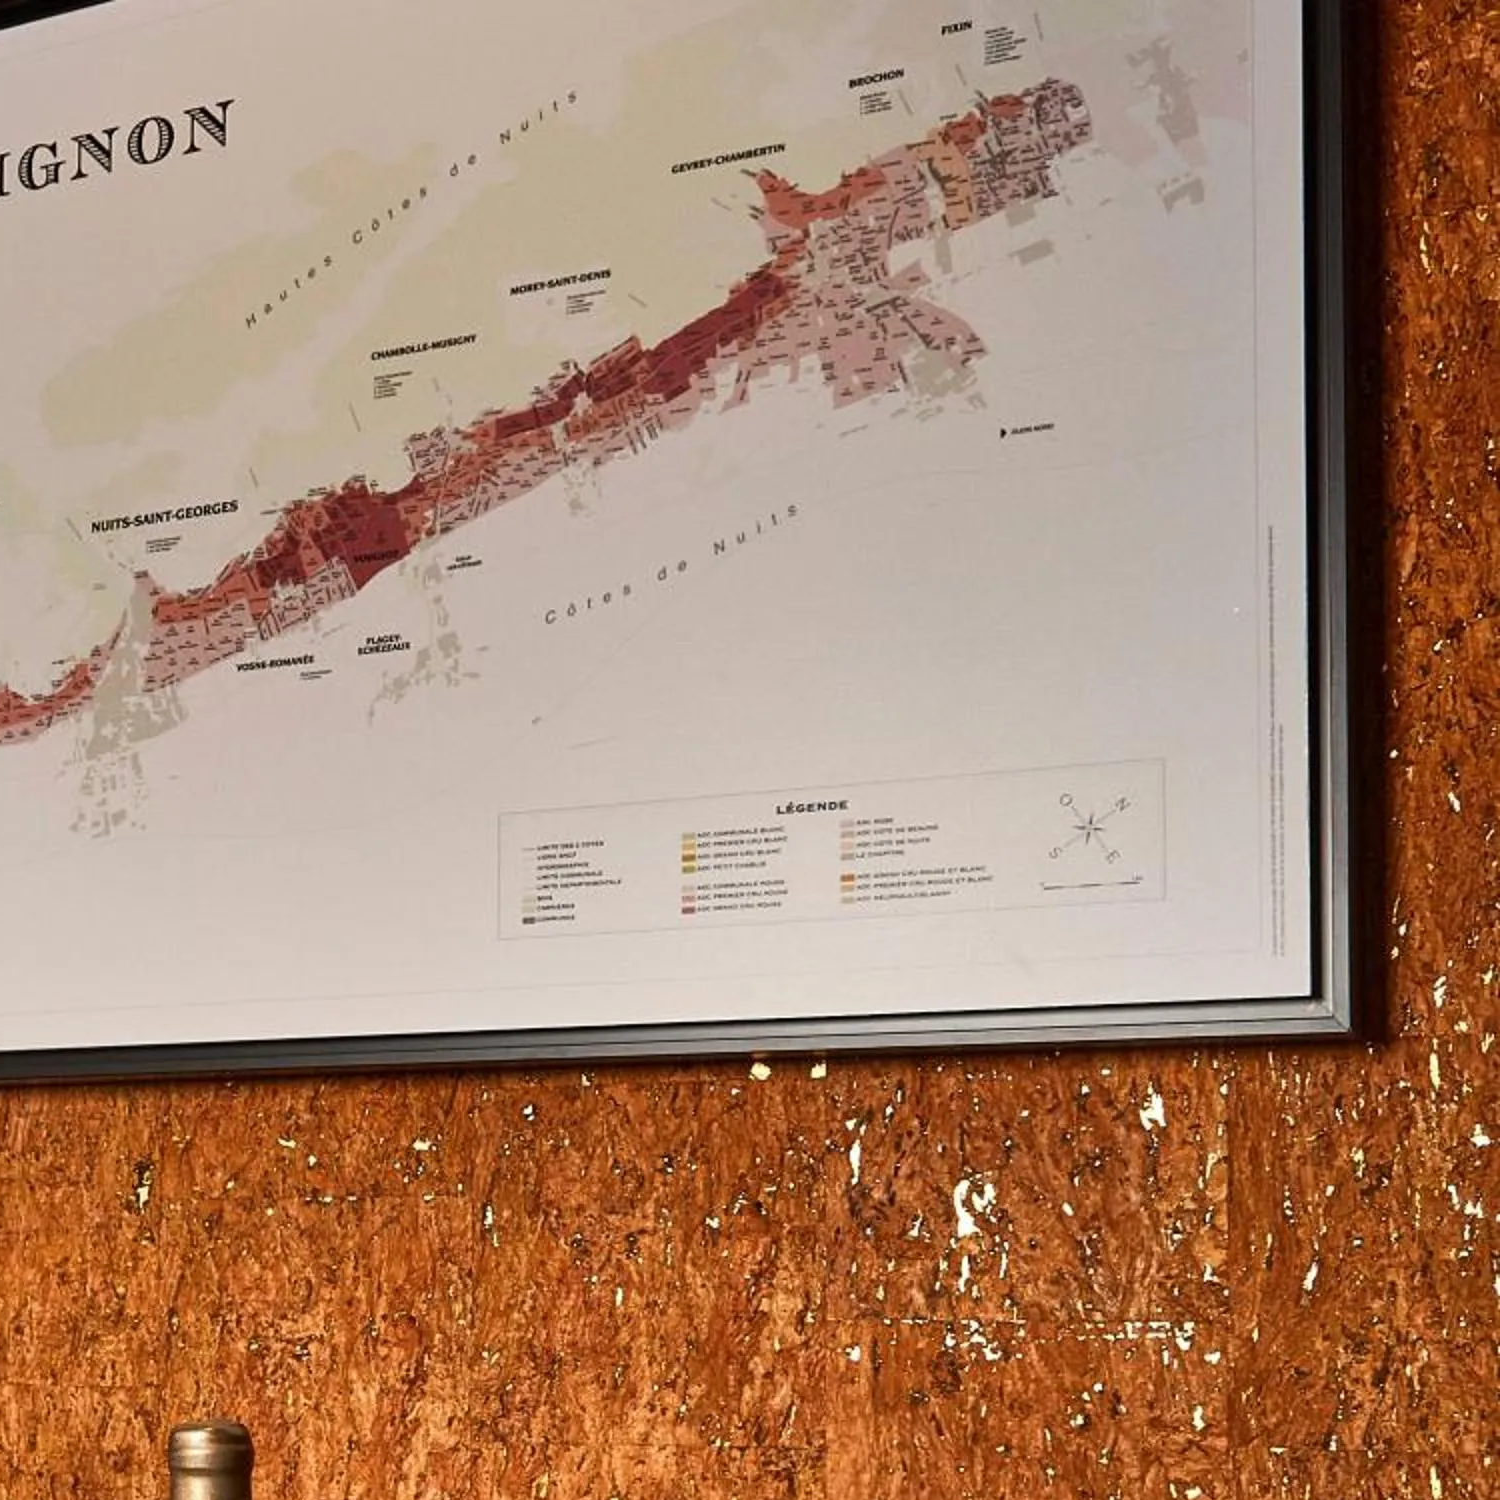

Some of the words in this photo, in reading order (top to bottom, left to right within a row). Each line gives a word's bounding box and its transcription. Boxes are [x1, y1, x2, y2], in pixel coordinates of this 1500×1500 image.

[245, 255, 333, 328] Hautes
[448, 153, 477, 178] de
[499, 90, 577, 144] Nuits
[91, 500, 239, 534] NUITS-SAINT-GEORGES
[656, 560, 689, 582] de
[713, 504, 798, 555] Nuits
[775, 799, 850, 816] LÉGENDE
